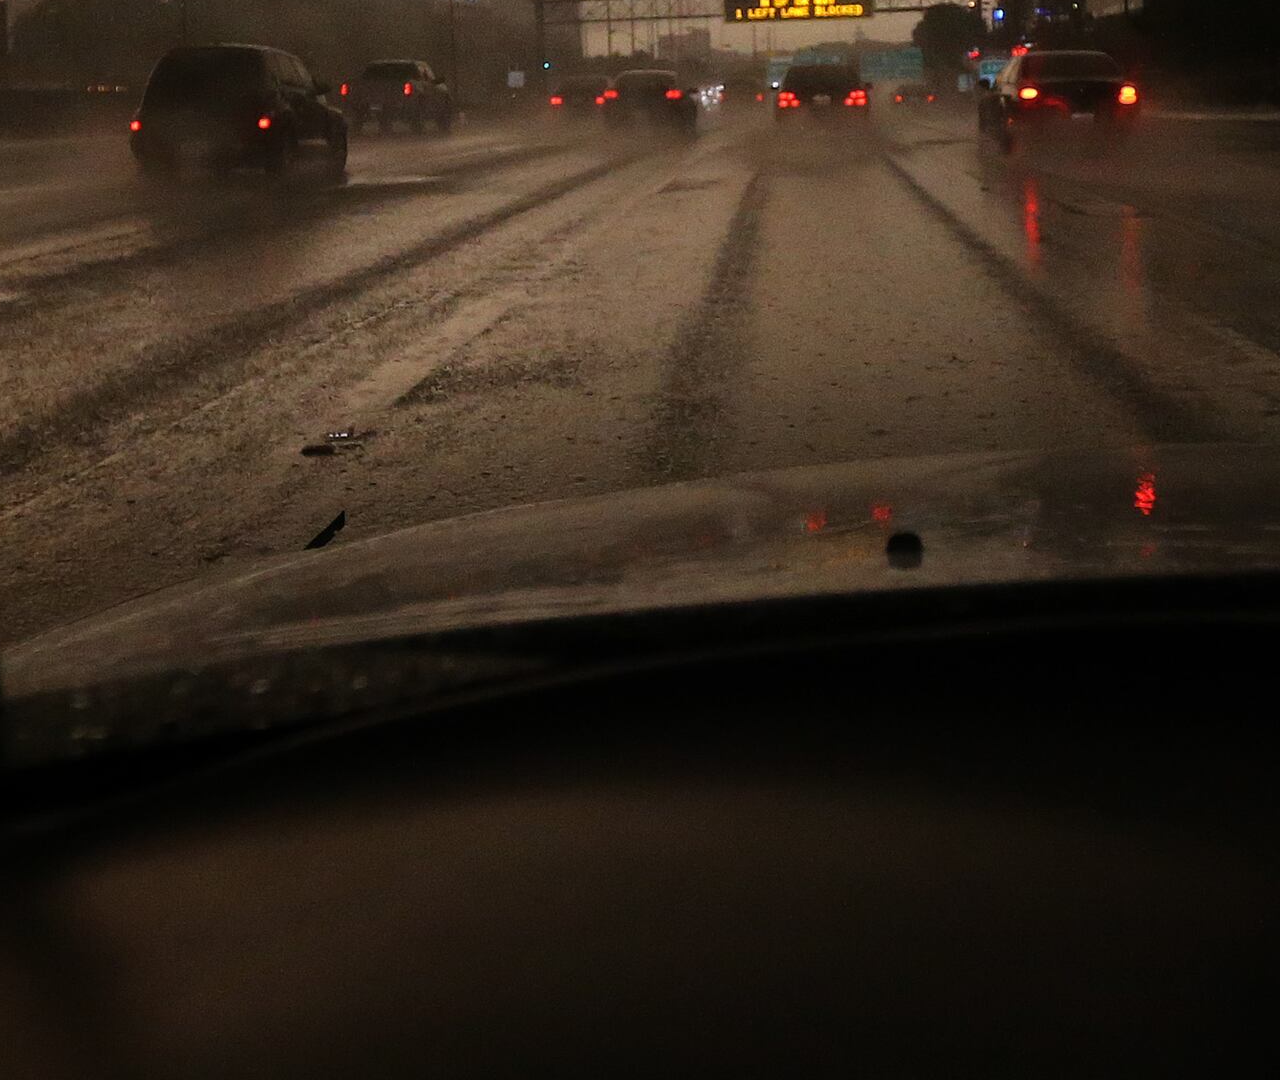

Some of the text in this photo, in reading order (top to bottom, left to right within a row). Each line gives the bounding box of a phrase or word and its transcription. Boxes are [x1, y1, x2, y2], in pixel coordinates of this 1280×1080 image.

[736, 4, 863, 19] 1 LEFT LANE BLOCKED
